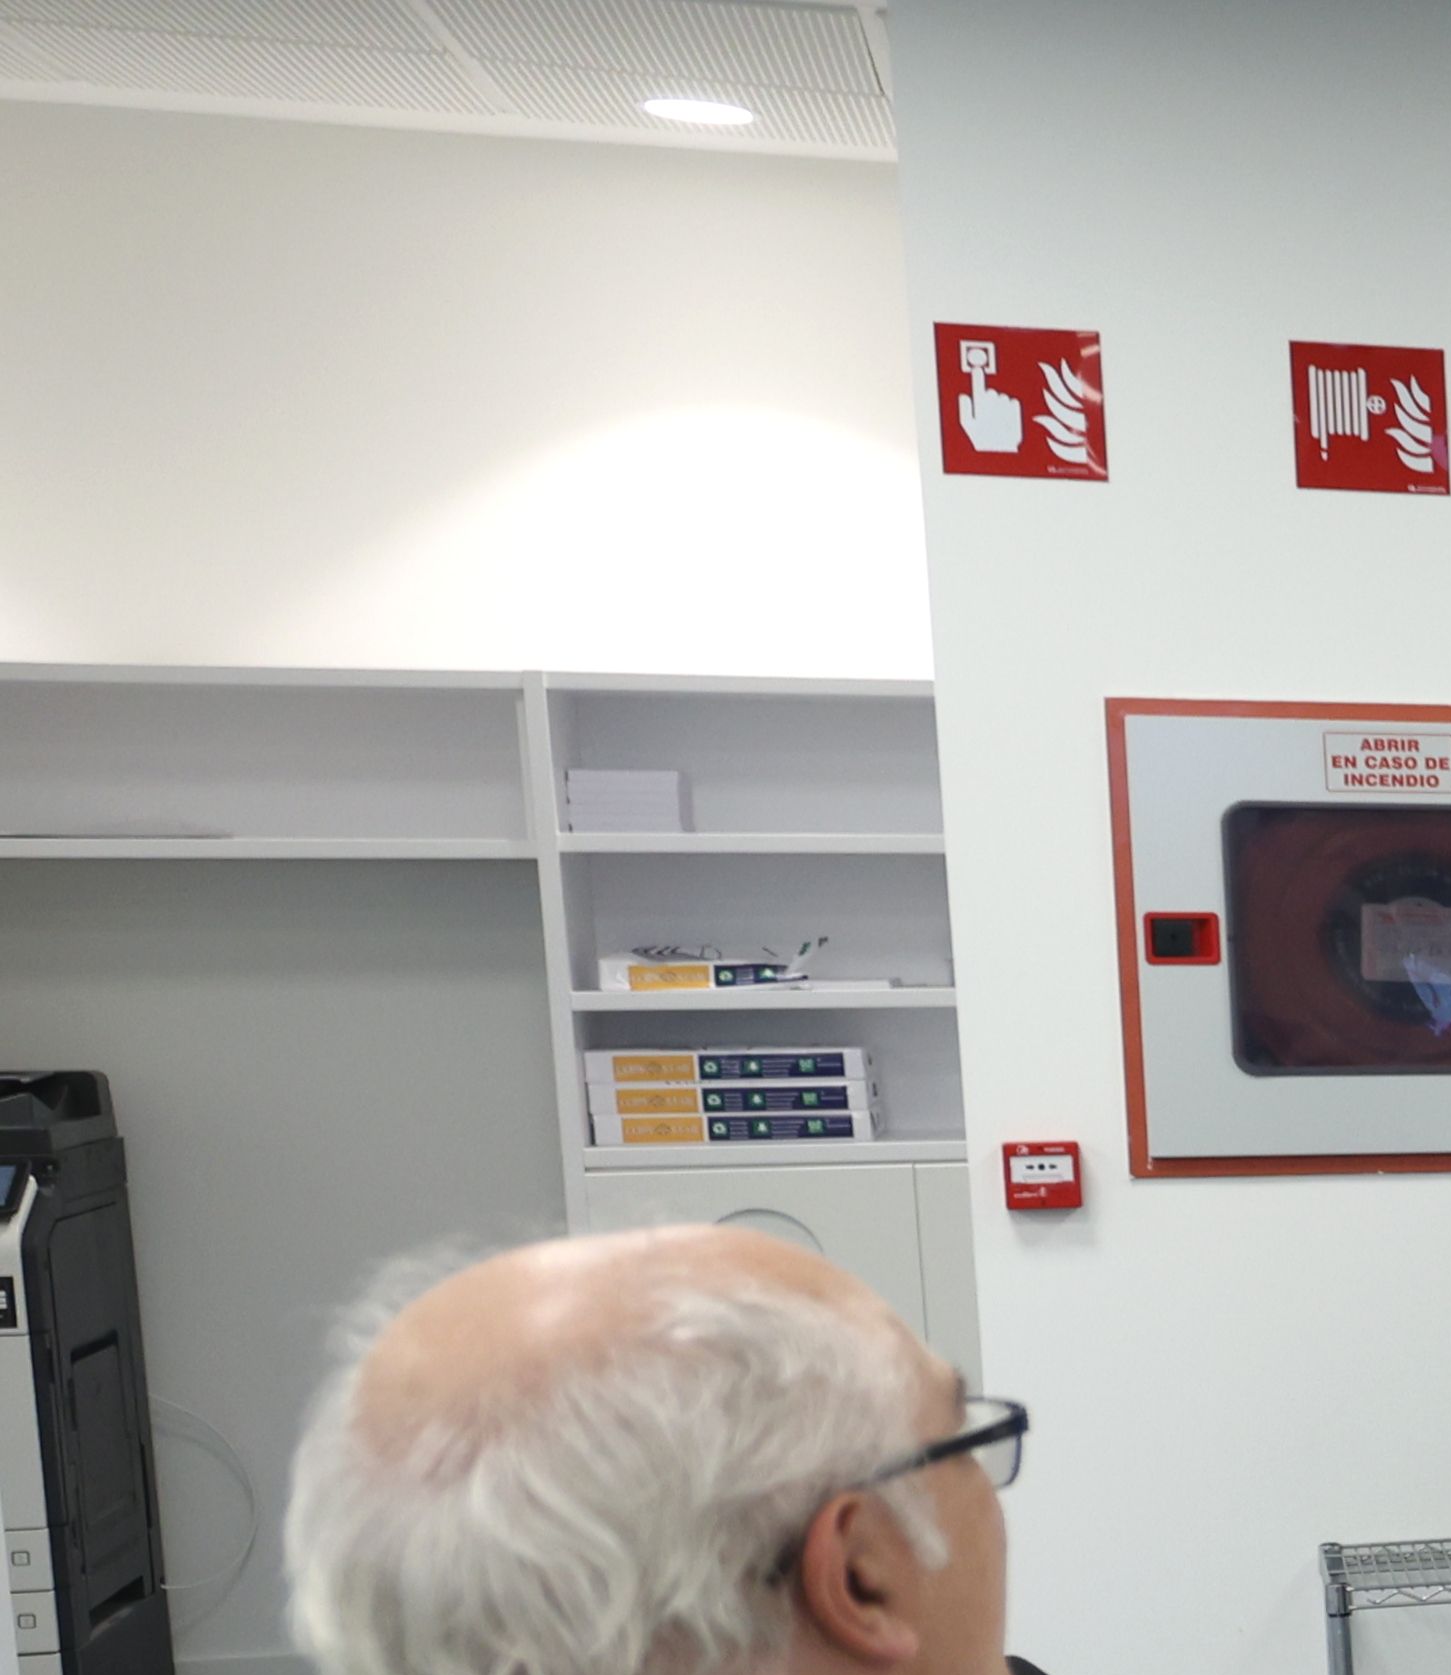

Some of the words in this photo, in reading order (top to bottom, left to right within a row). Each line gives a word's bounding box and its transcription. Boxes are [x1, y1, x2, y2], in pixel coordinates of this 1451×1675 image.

[1360, 738, 1420, 752] ABRIR
[1331, 755, 1357, 768] EN
[1364, 755, 1418, 770] CASO
[1424, 757, 1450, 771] DE
[1343, 773, 1440, 788] INCENDIO
